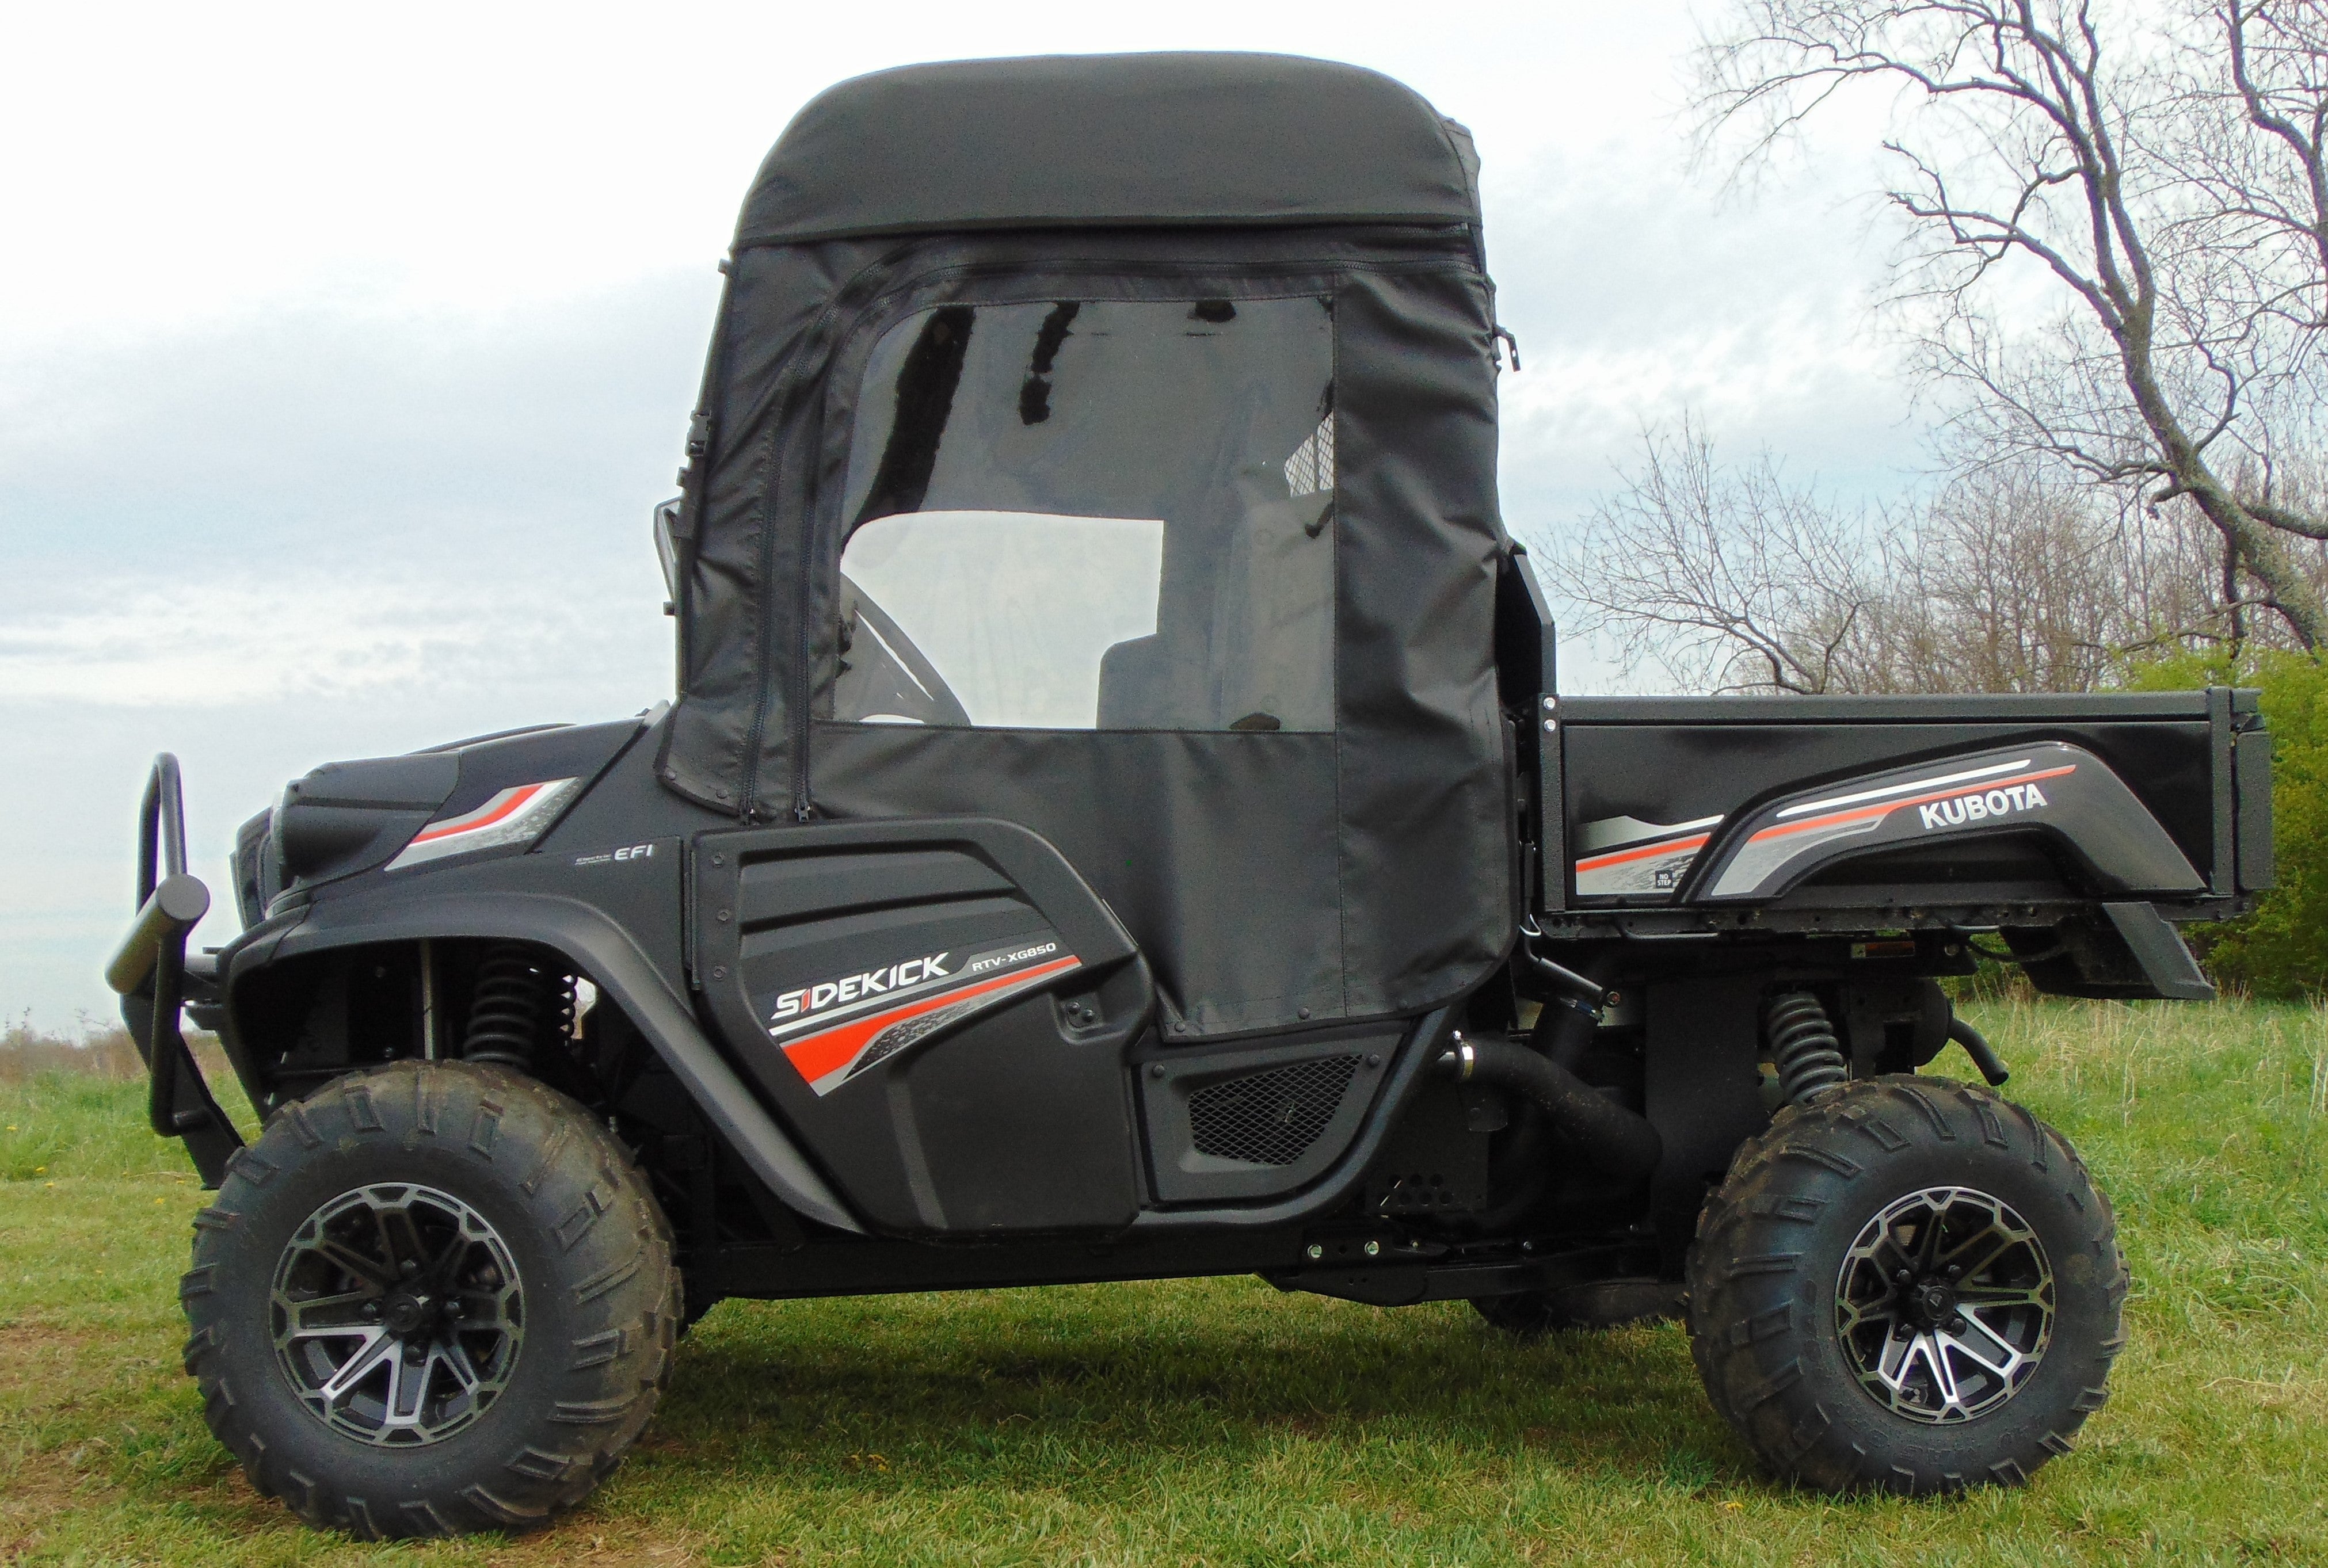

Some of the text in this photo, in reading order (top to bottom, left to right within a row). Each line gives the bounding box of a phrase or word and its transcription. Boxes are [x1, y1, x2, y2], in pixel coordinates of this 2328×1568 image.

[1919, 783, 2048, 829] KUBOTA
[614, 844, 653, 861] EFI
[971, 942, 1057, 972] RTV-XG850
[771, 952, 951, 1020] SIDEKICK
